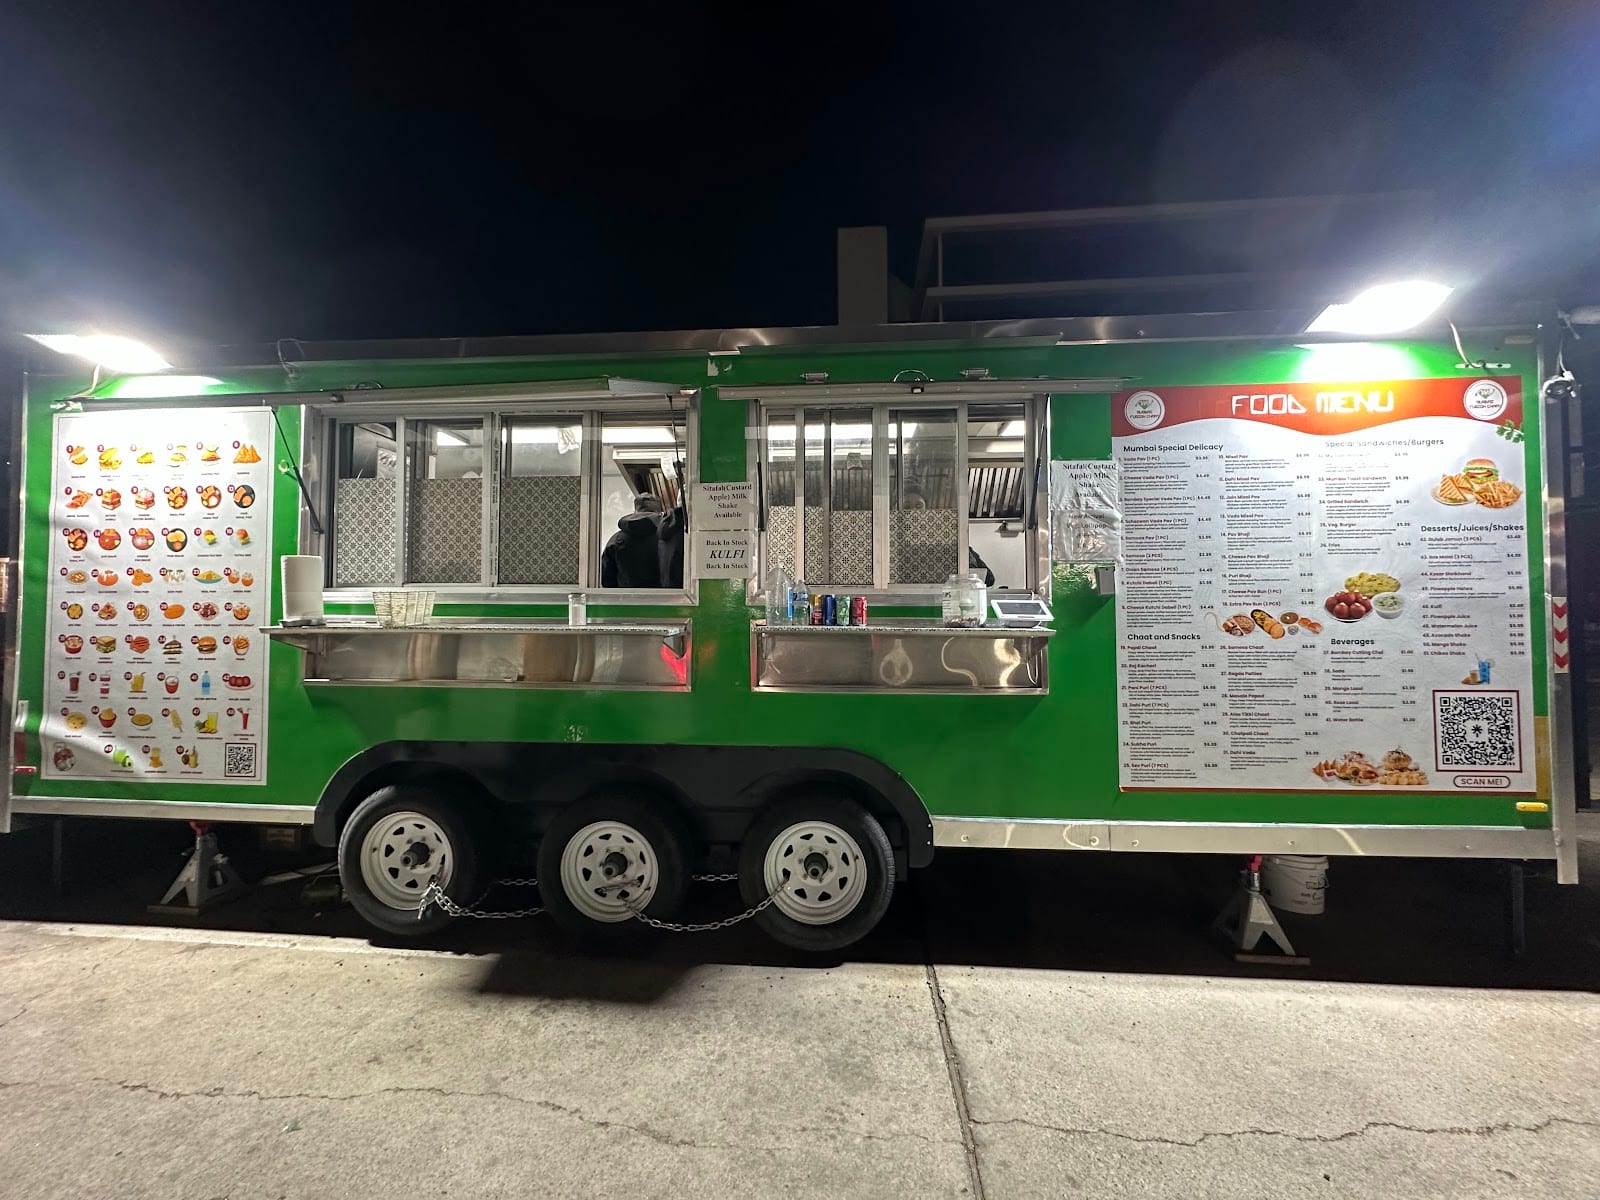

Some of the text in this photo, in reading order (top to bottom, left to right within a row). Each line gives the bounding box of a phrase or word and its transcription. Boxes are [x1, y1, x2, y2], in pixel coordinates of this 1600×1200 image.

[1232, 390, 1394, 415] FOOD MENU
[1158, 445, 1187, 453] Special
[1189, 444, 1224, 452] Delicacy
[1421, 523, 1524, 532] Desserts/Juices/Shakes
[710, 550, 744, 558] KULFI
